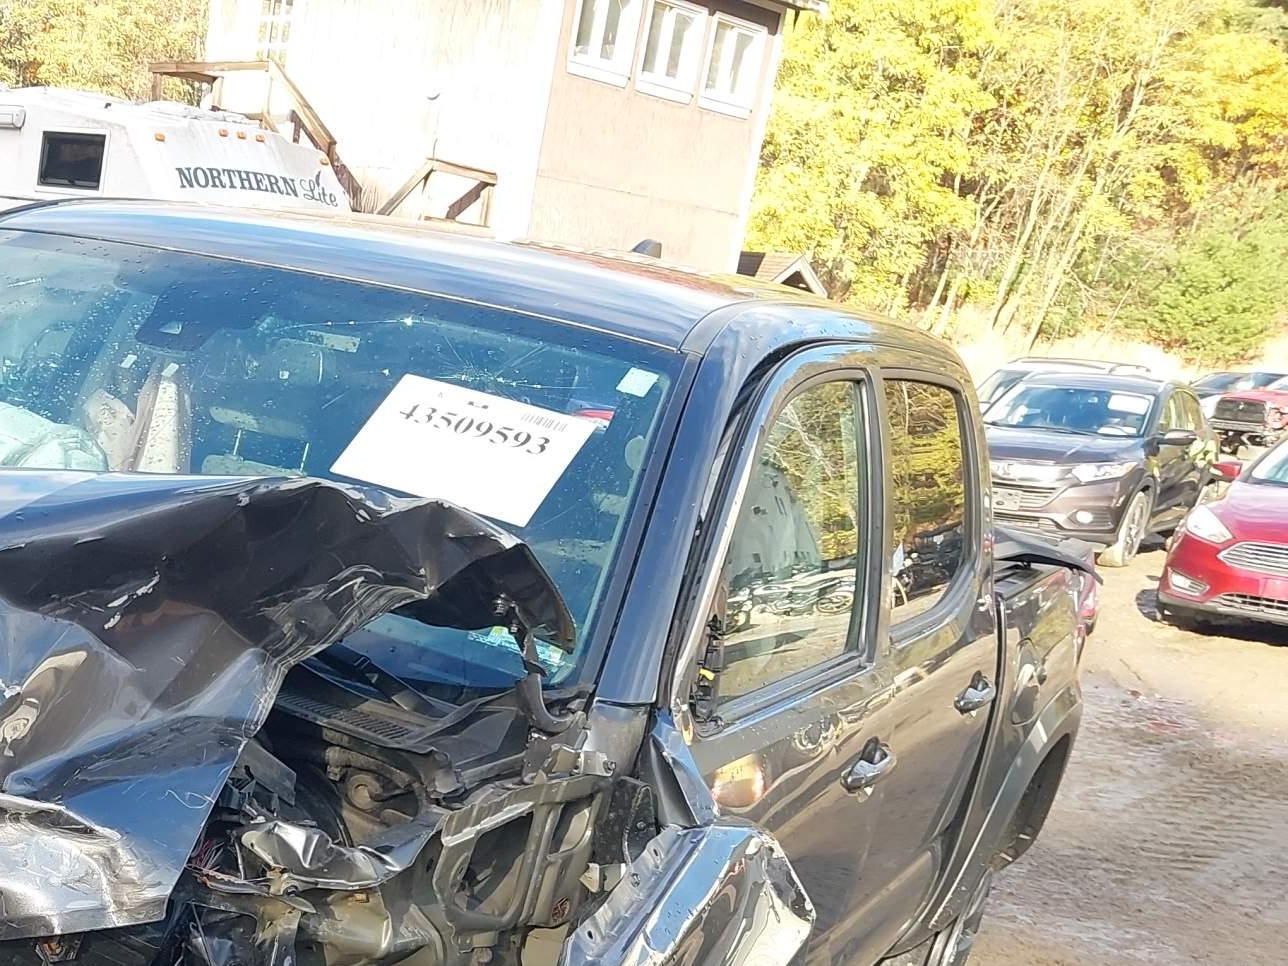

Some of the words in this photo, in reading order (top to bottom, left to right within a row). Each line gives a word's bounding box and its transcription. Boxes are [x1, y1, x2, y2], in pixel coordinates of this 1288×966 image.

[175, 166, 299, 198] NORTHERN
[299, 170, 339, 207] Lite
[399, 403, 551, 455] 43509593
